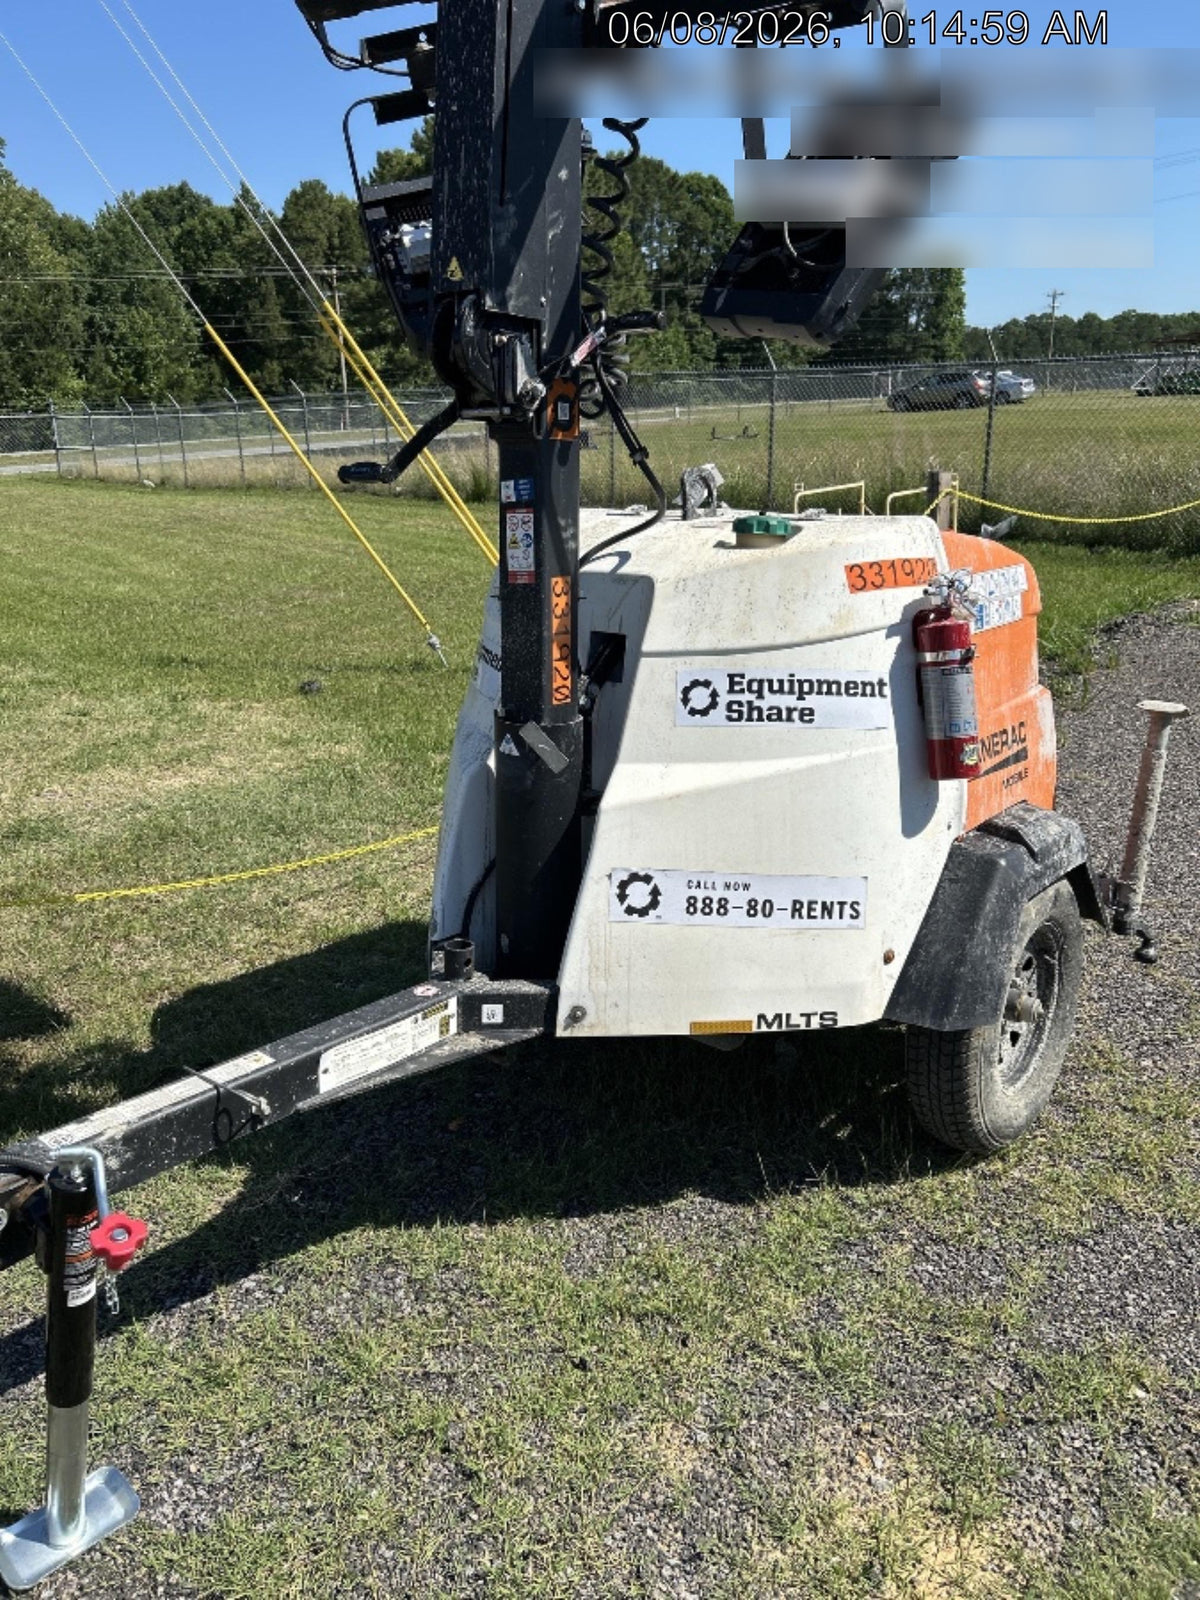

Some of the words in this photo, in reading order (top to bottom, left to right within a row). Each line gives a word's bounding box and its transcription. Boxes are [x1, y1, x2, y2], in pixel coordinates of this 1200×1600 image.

[551, 579, 570, 701] 331920
[726, 673, 887, 701] Equipment
[725, 700, 816, 724] Share
[978, 721, 1028, 763] NERAC
[686, 879, 717, 891] CALL
[723, 881, 751, 892] NOW
[685, 895, 861, 920] 888-80-RENTS
[756, 1011, 838, 1030] MLTS
